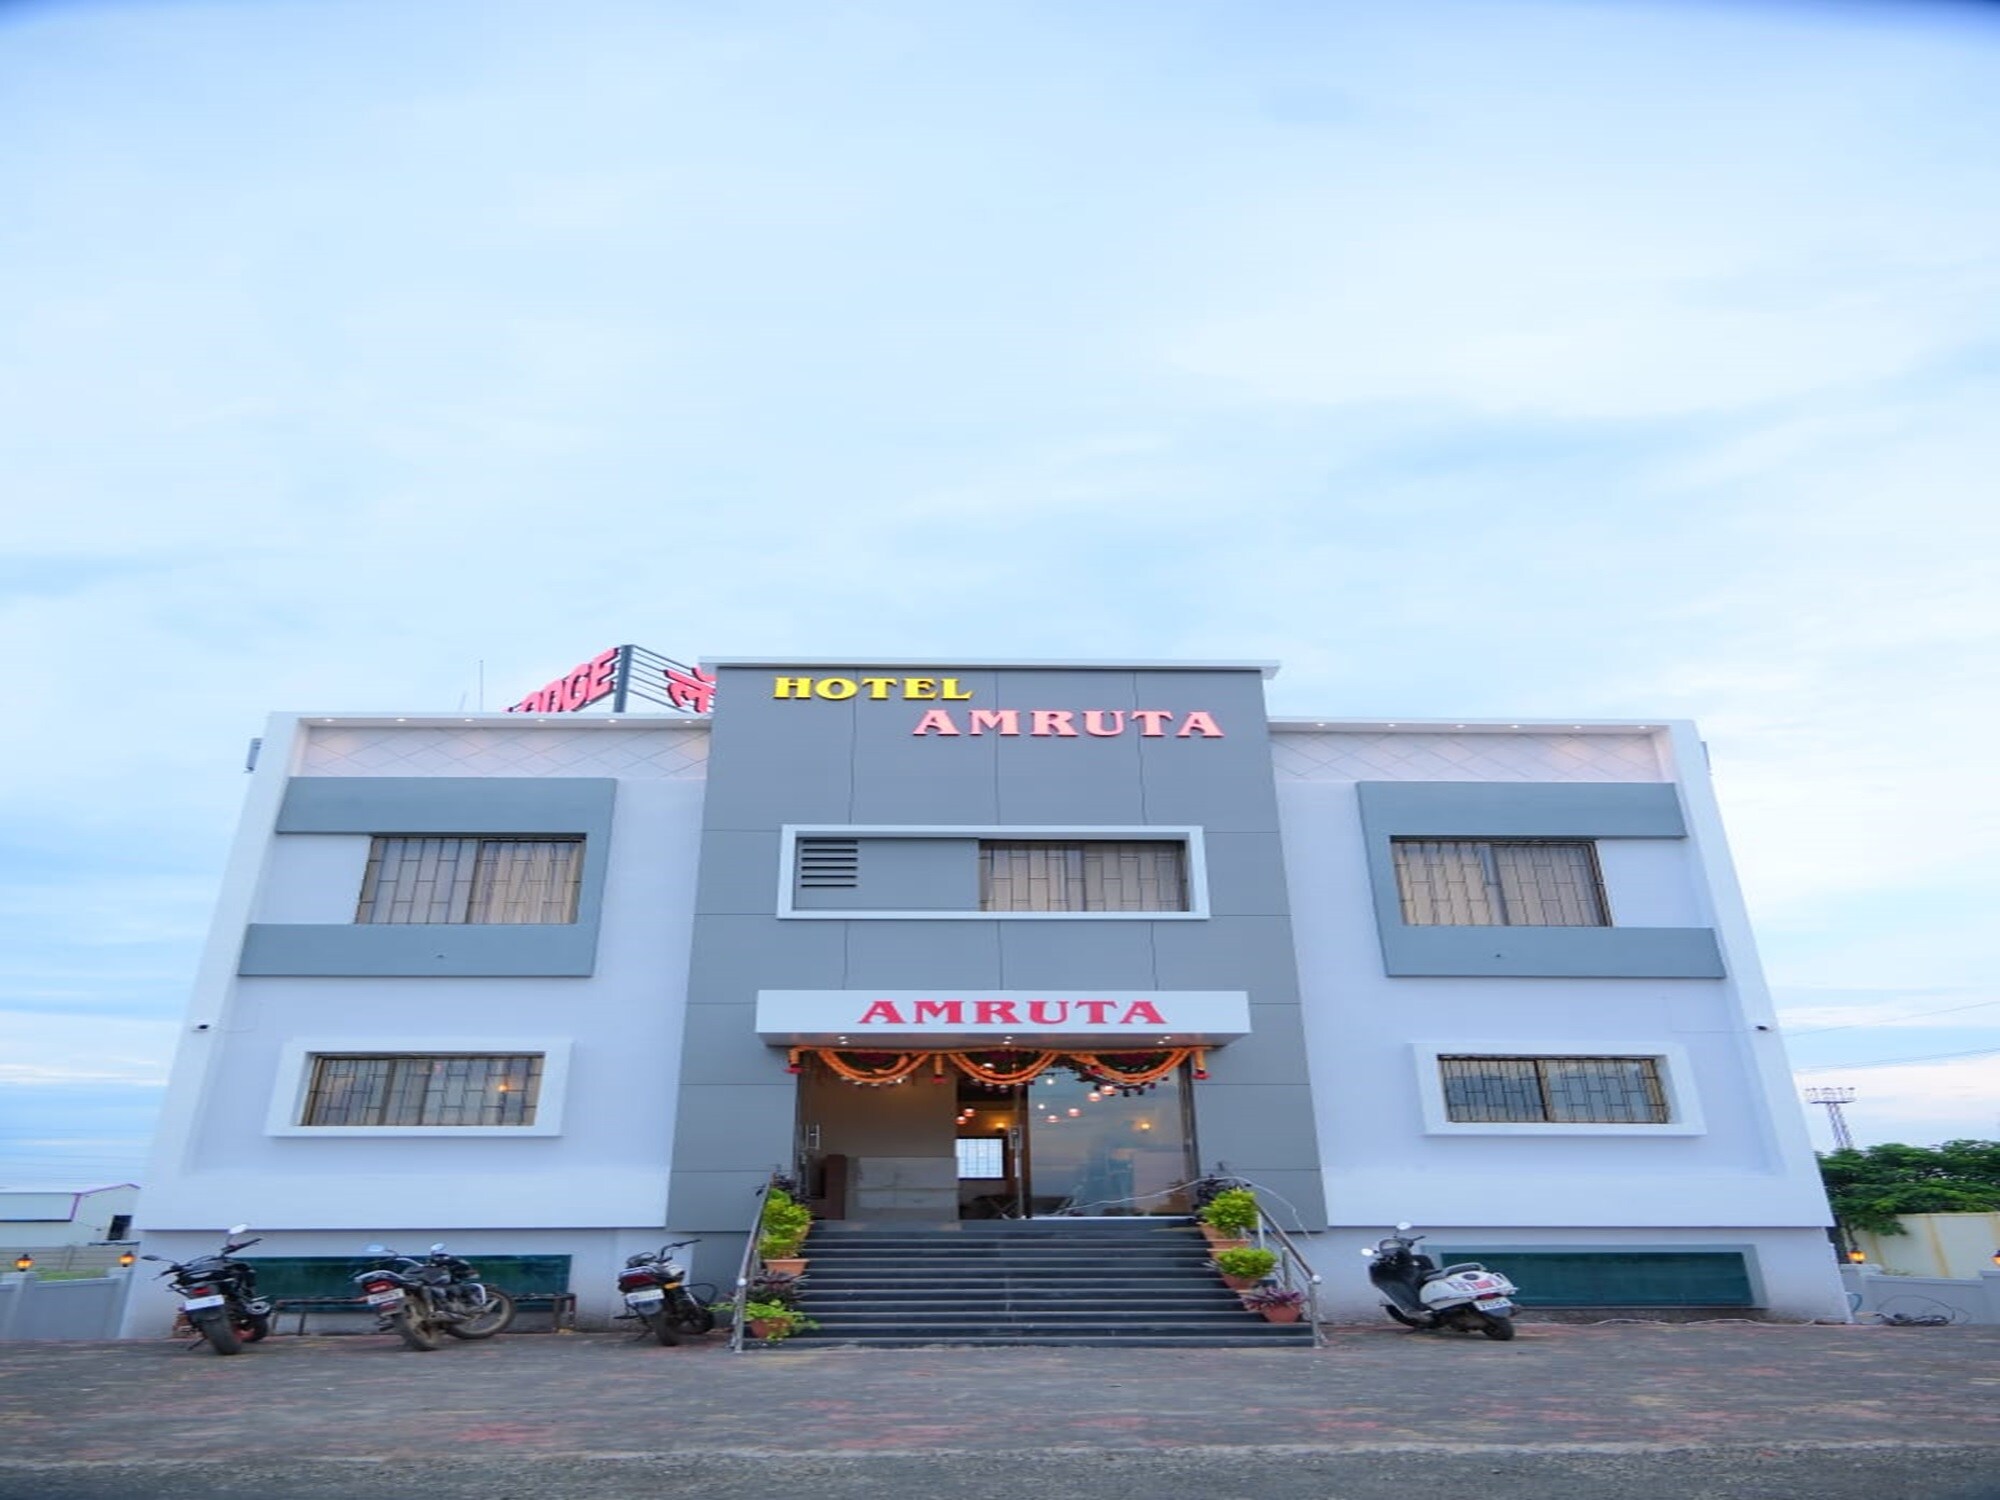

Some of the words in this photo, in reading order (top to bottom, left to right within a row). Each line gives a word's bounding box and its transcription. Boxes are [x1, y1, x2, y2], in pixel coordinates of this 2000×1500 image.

[500, 647, 619, 712] ODGE
[773, 676, 974, 701] HOTEL
[912, 708, 1225, 738] AMRUTA
[858, 1000, 1167, 1024] AMRUTA
